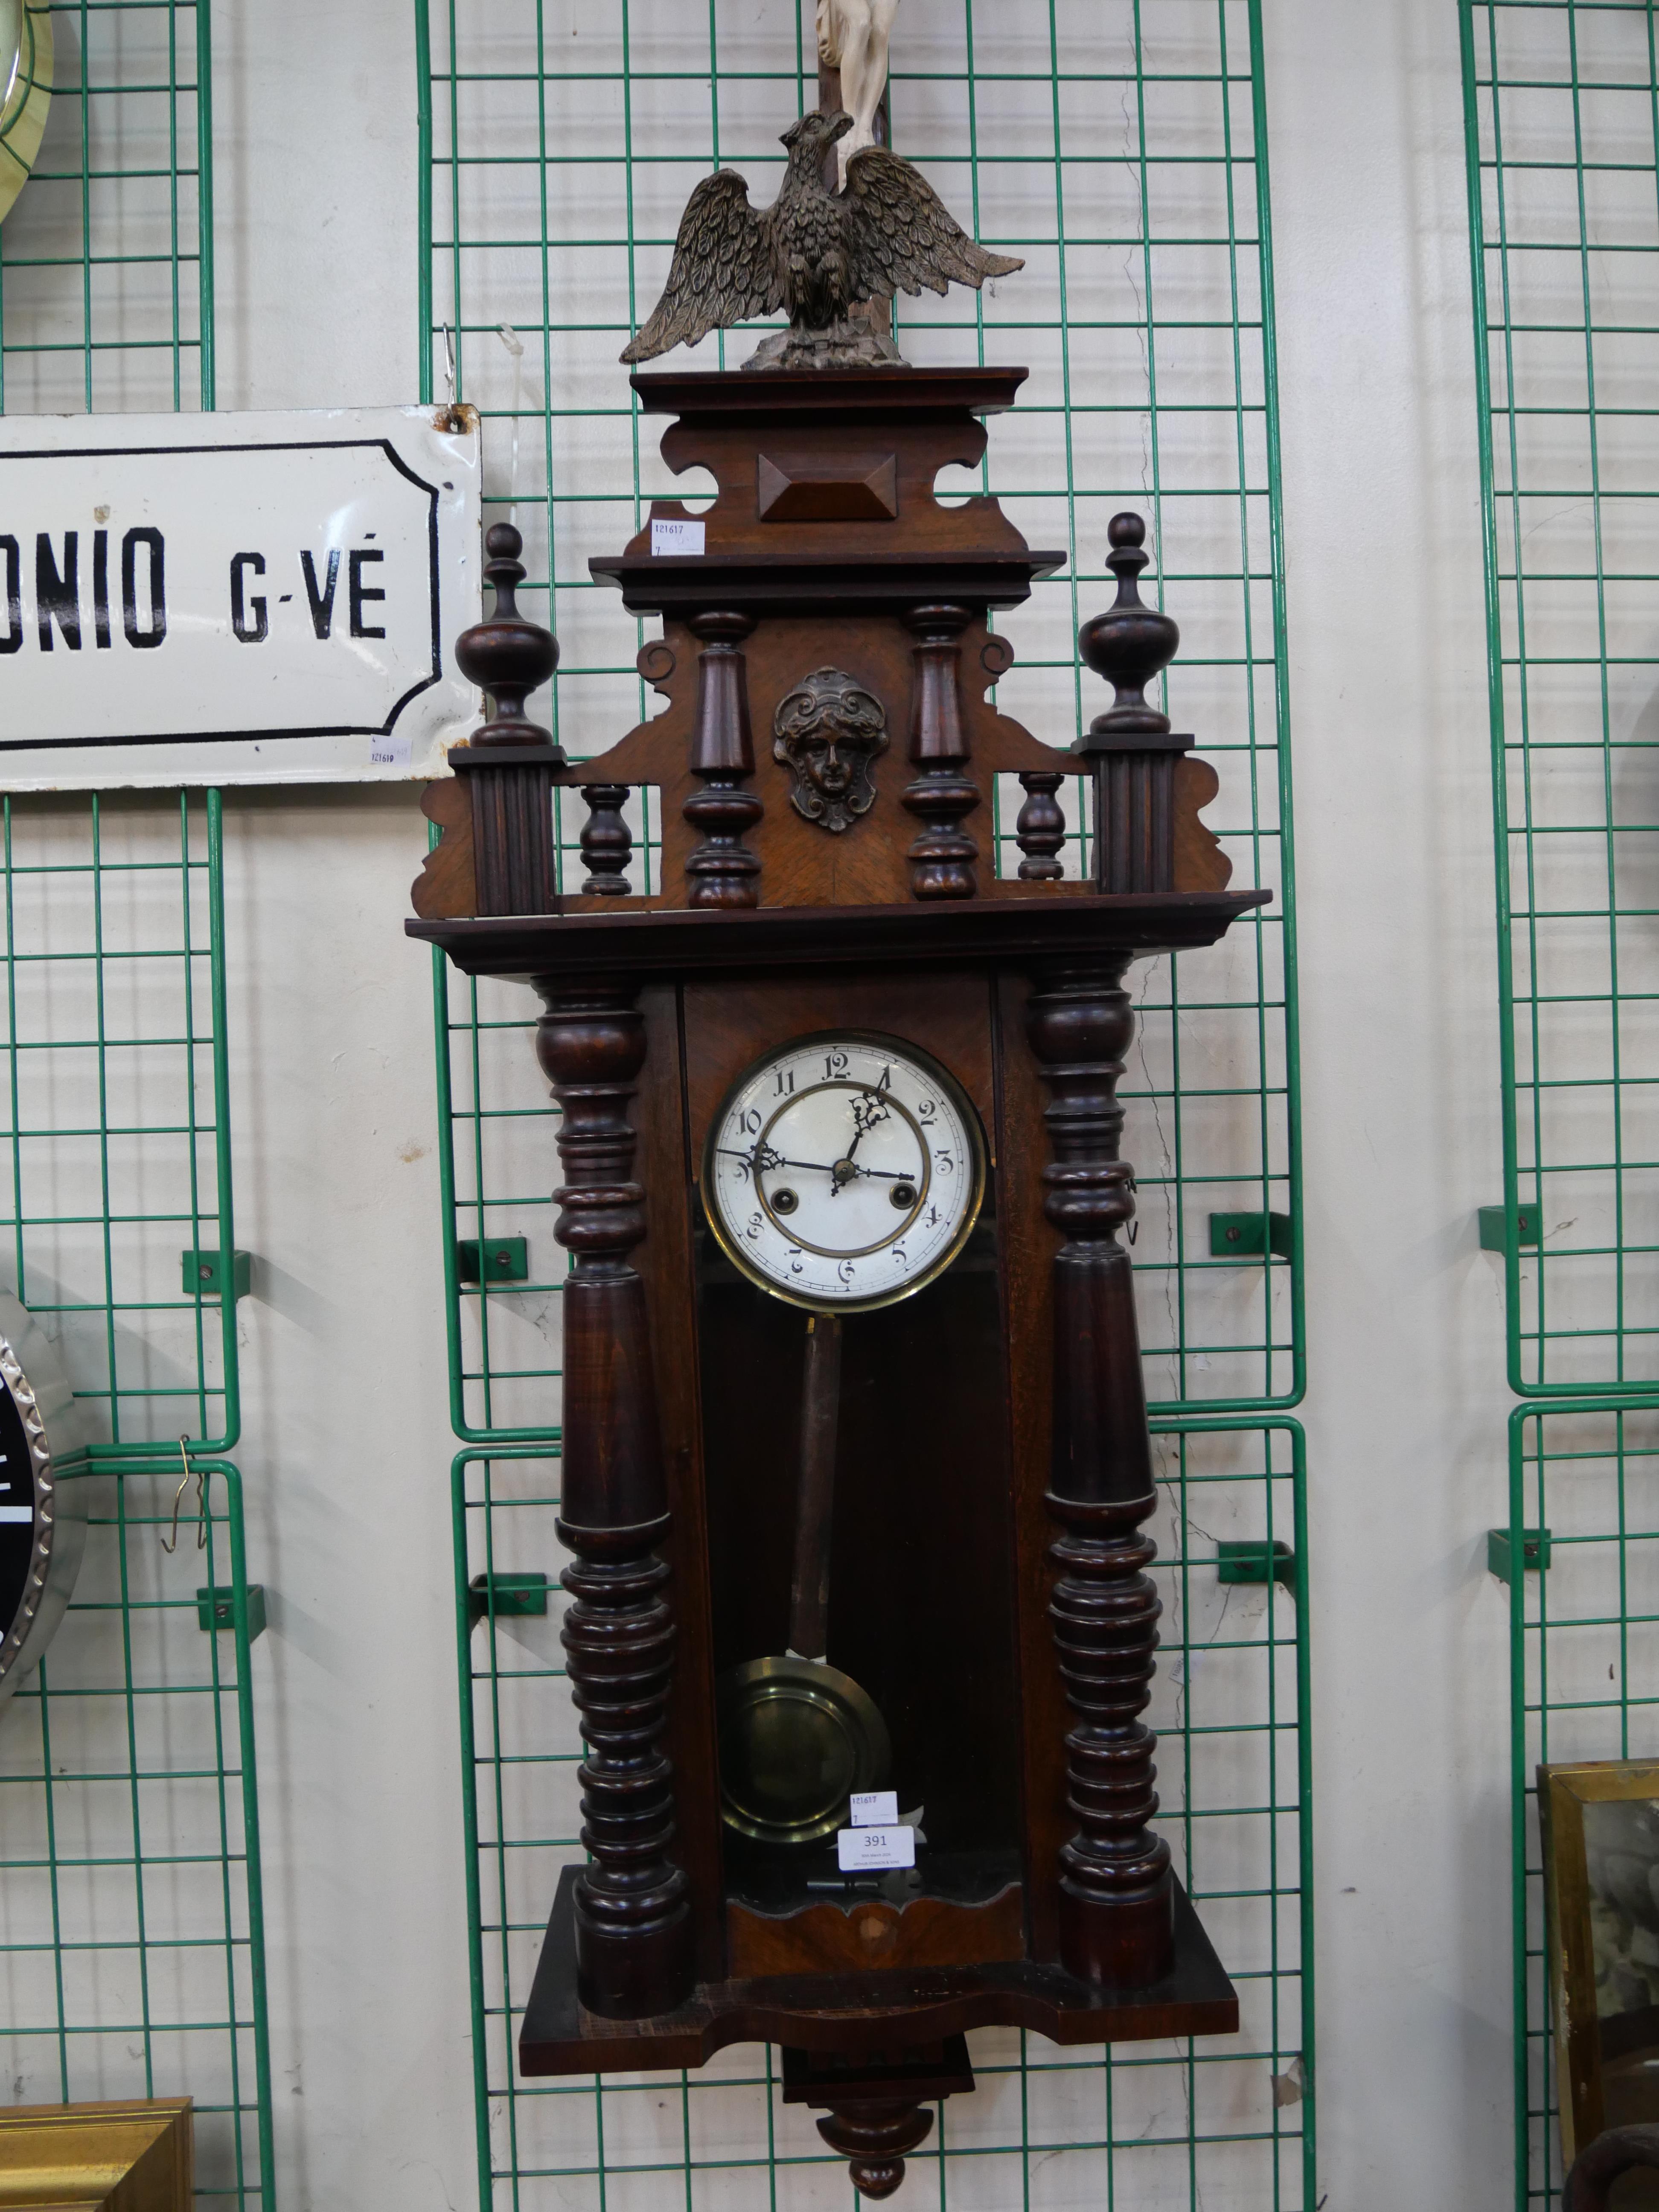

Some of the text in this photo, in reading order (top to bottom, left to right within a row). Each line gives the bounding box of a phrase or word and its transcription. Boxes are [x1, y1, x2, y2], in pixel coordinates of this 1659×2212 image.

[656, 525, 683, 533] 121617
[821, 1053, 850, 1080] 12
[881, 1064, 892, 1091] 1
[773, 1070, 795, 1097] 11
[736, 1109, 761, 1135] 10
[919, 1100, 937, 1125] 2
[732, 1161, 749, 1185] 9
[934, 1150, 953, 1176] 3
[747, 1212, 764, 1239] 8
[922, 1200, 943, 1228] 4
[784, 1249, 803, 1273] 7
[892, 1240, 906, 1268] 5
[838, 1258, 855, 1284] 6
[852, 1796, 877, 1805] 121617
[864, 1836, 887, 1846] 391
